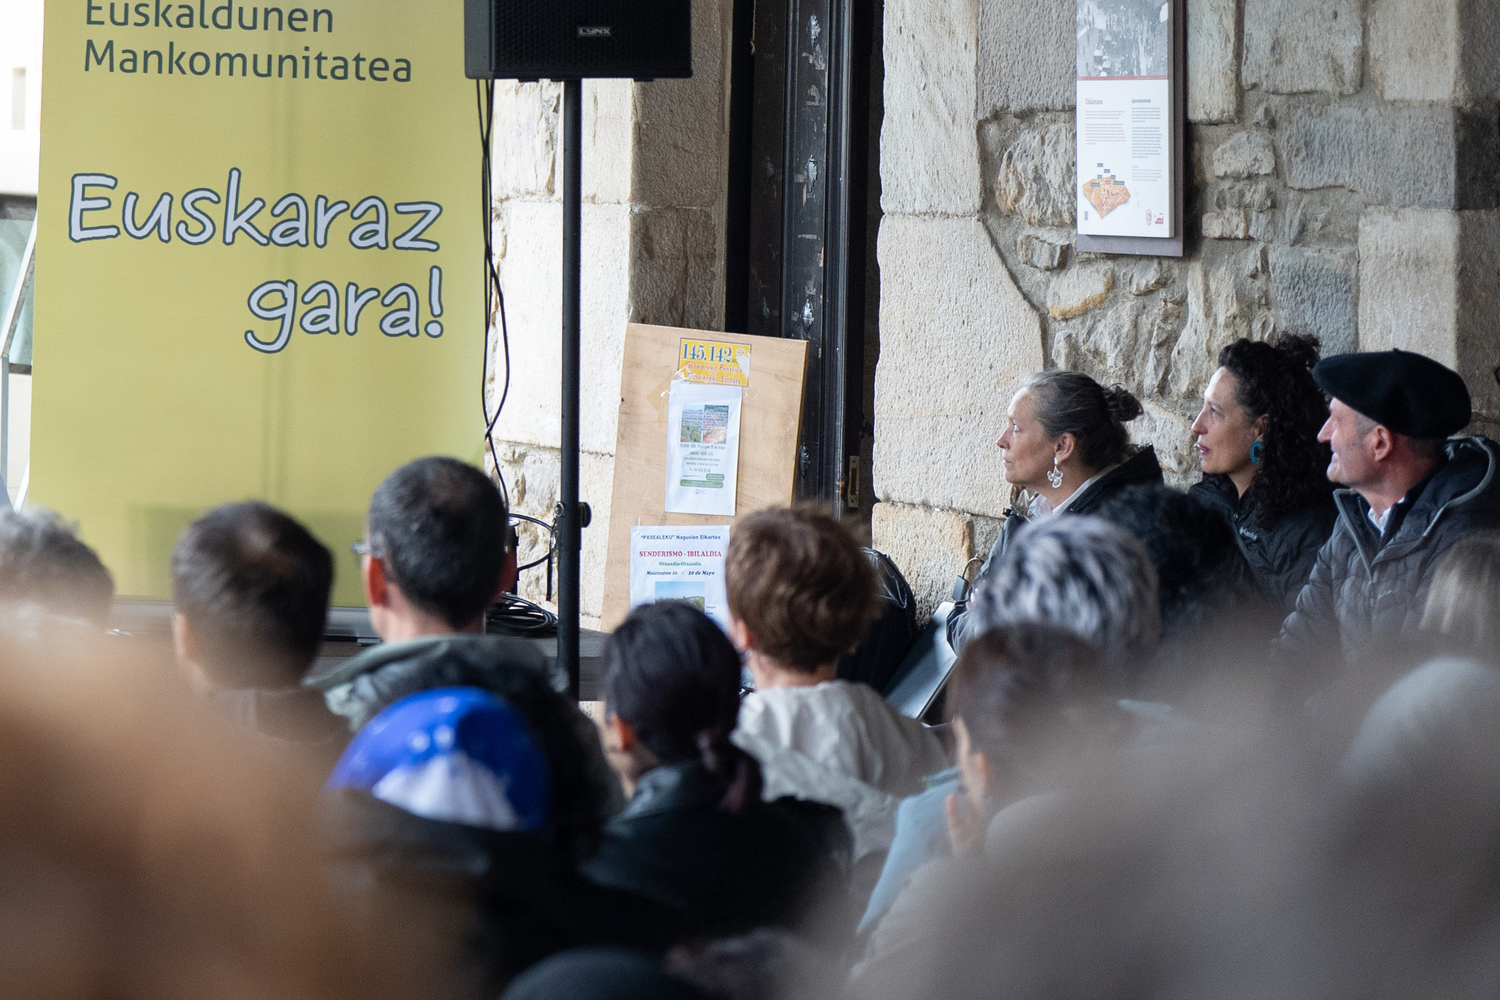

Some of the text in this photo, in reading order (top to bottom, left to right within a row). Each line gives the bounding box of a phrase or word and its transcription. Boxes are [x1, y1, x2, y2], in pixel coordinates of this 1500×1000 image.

[84, 39, 413, 83] Mankomunitatea
[68, 167, 443, 252] Euskaraz
[244, 265, 444, 354] gara!
[682, 343, 732, 363] 145.142
